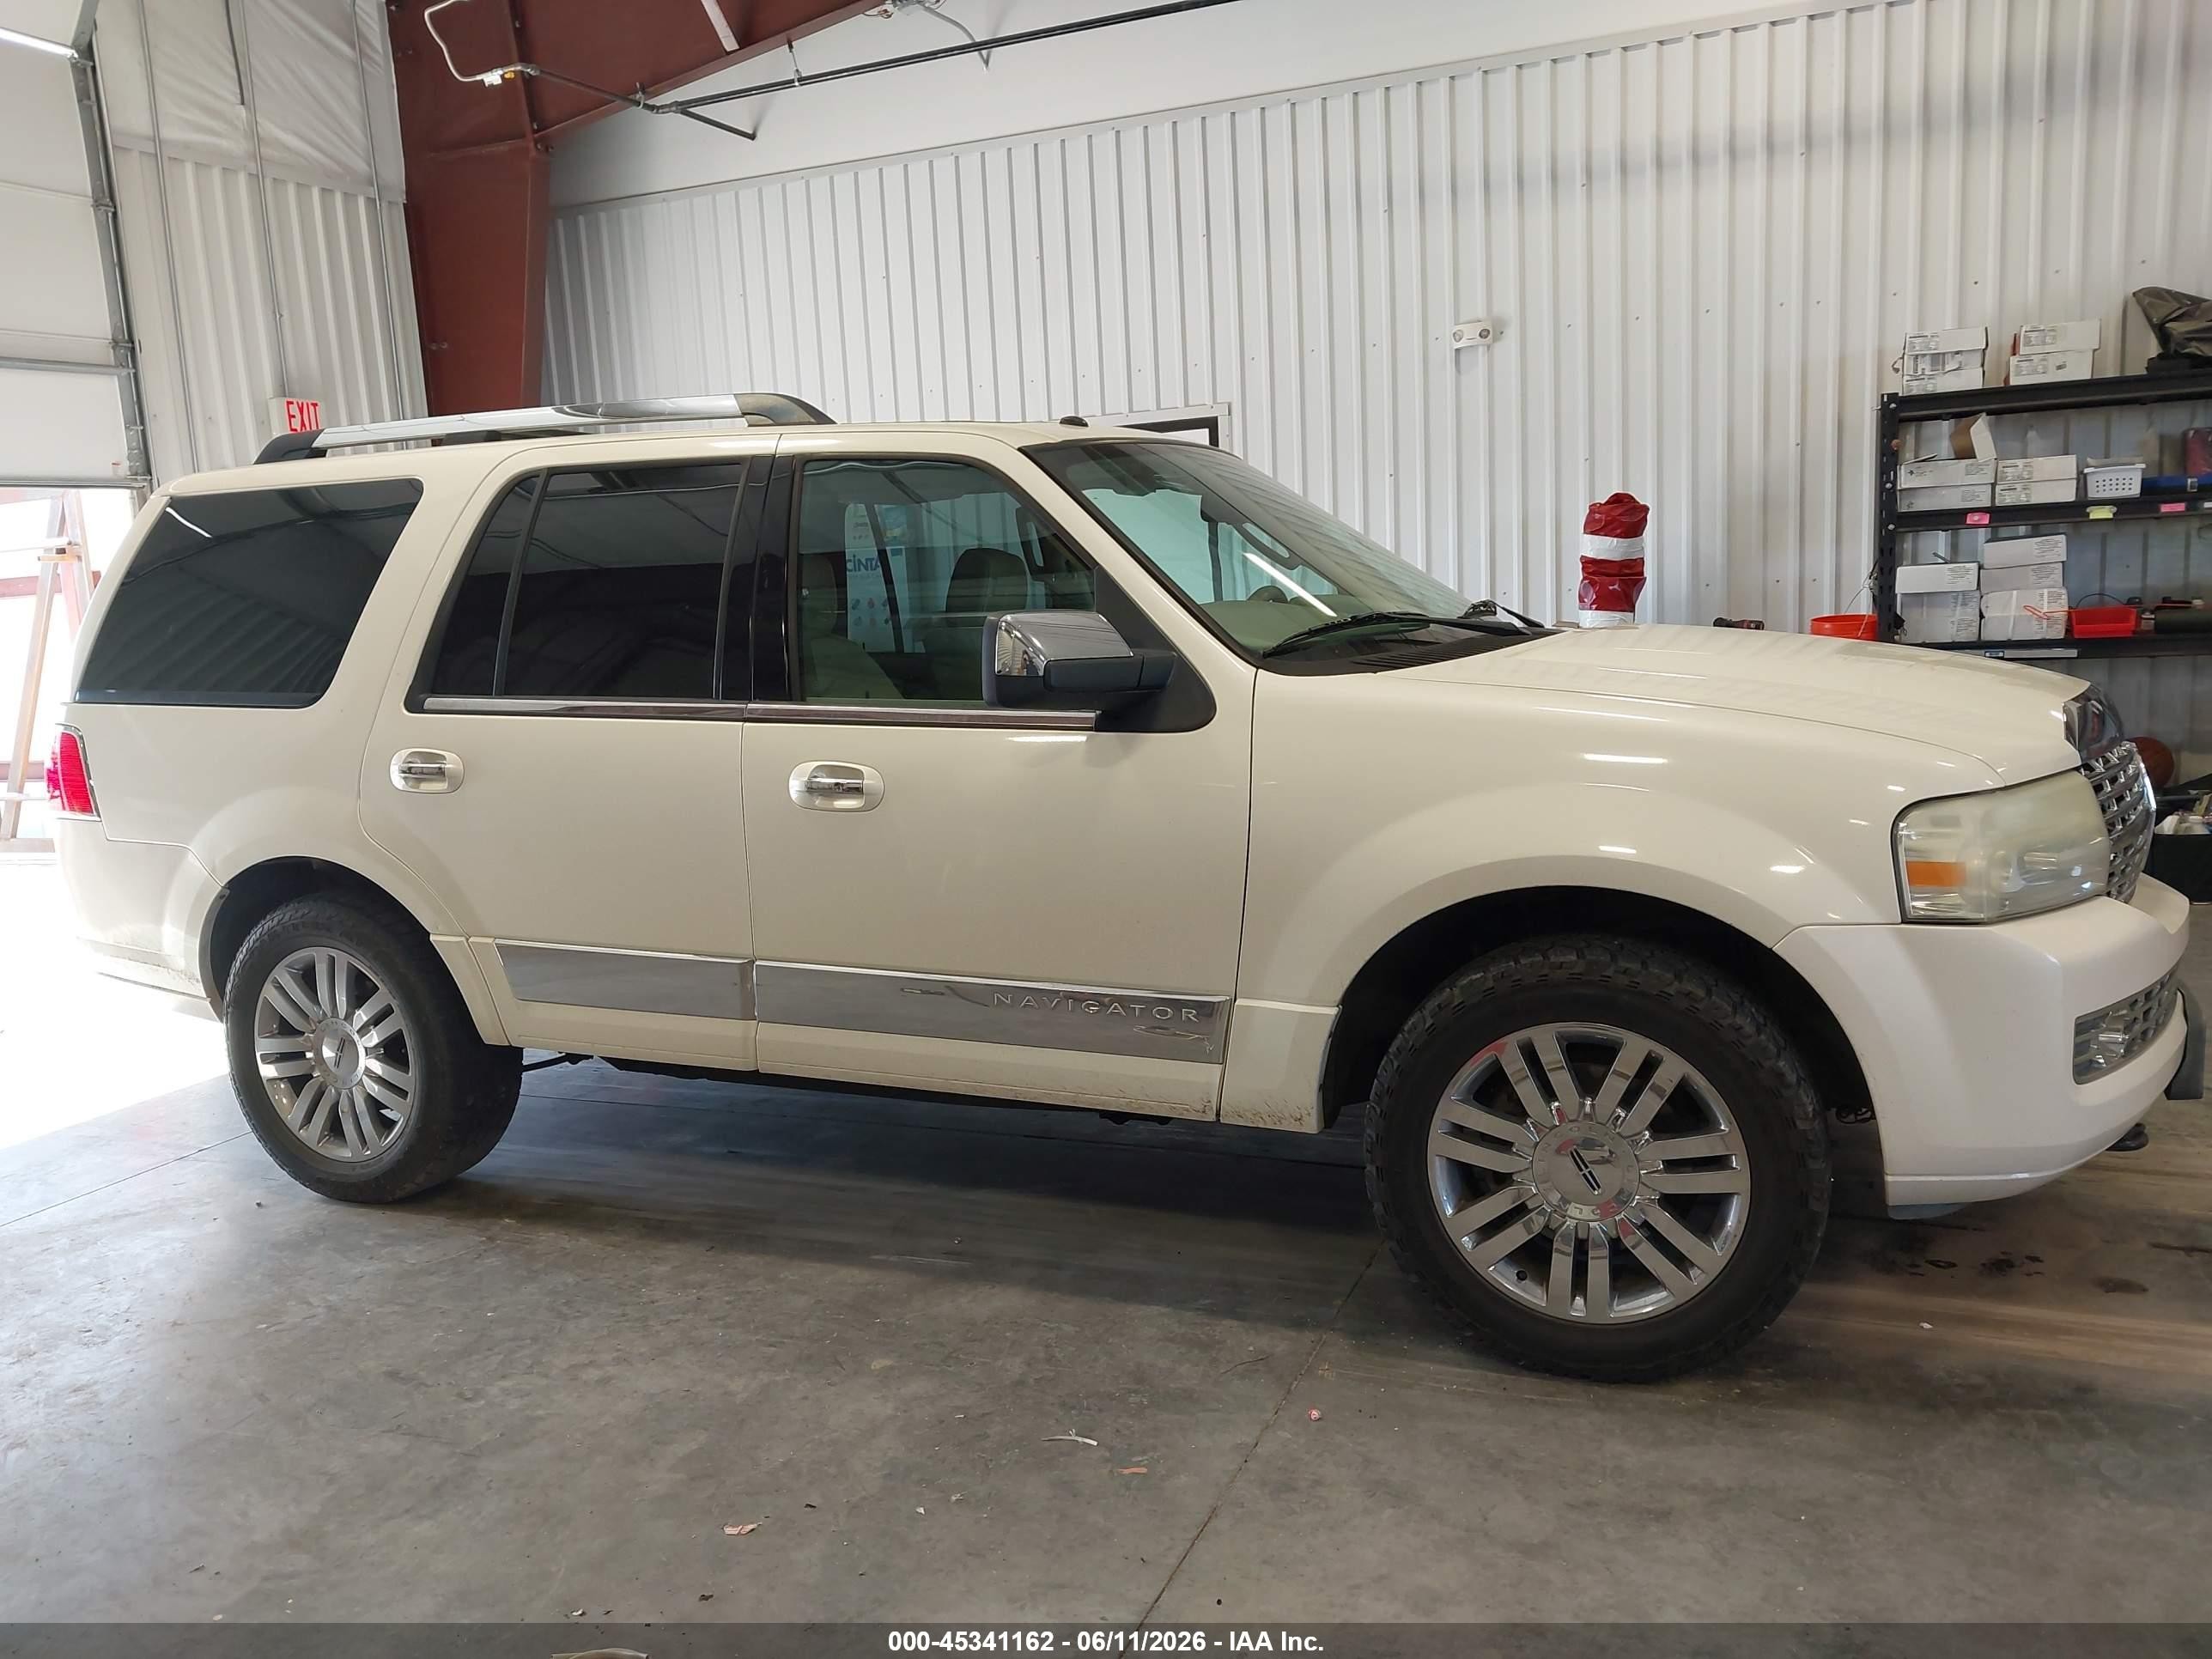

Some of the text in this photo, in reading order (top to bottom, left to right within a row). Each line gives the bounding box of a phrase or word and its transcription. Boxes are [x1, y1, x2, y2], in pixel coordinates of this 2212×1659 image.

[286, 400, 319, 432] EXIT
[846, 553, 880, 573] CINTA
[994, 993, 1200, 1023] NAVIGATOR
